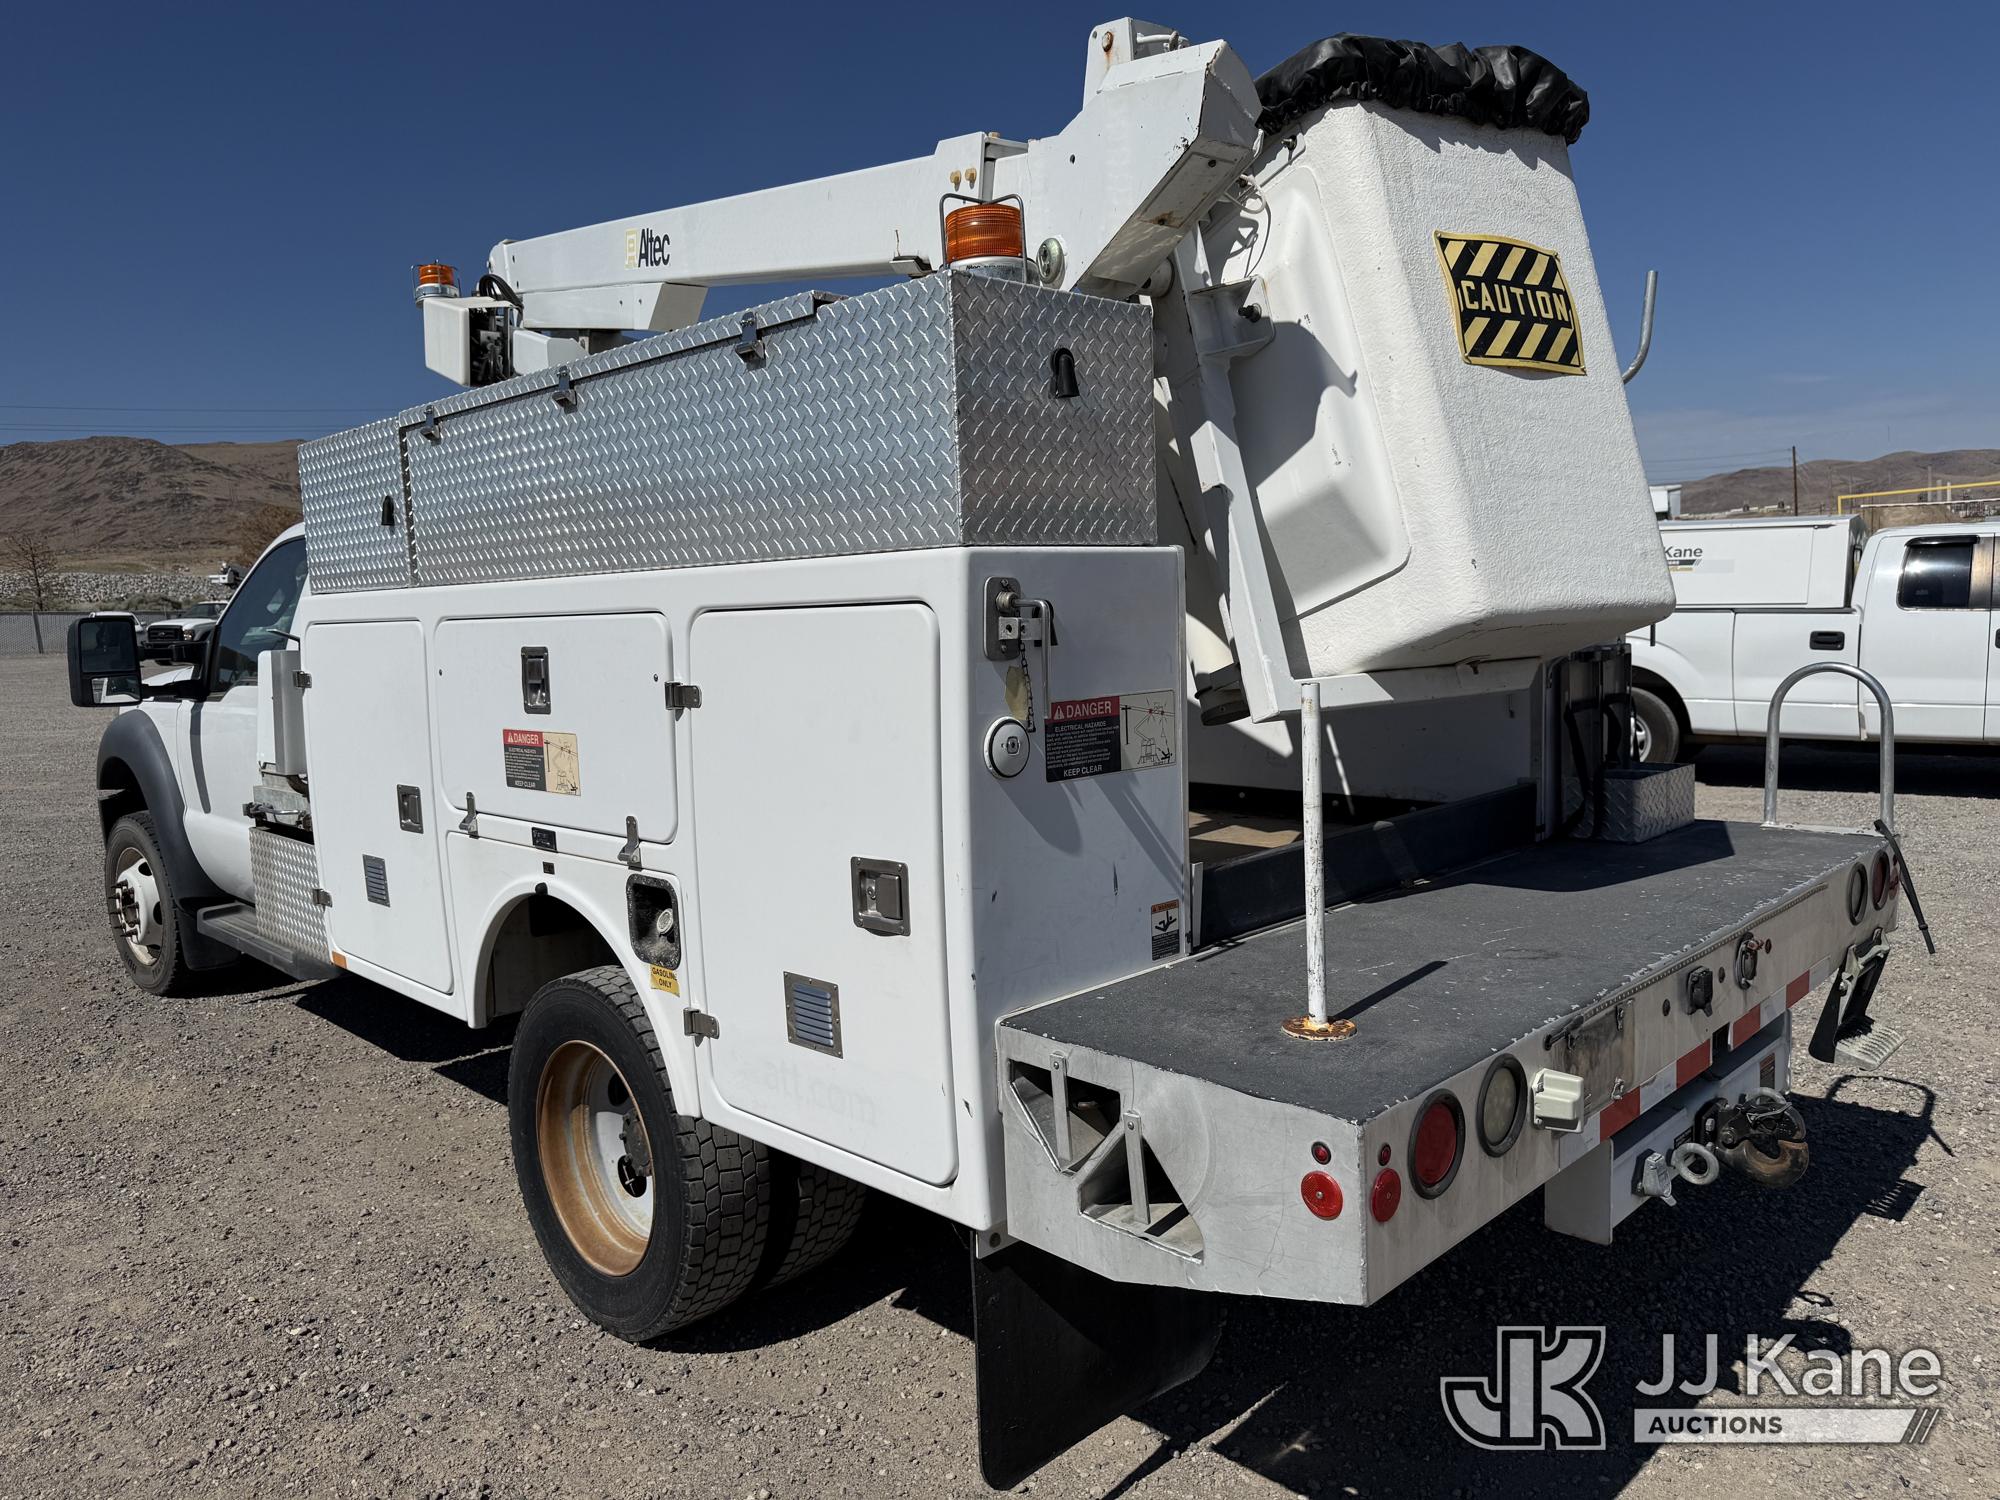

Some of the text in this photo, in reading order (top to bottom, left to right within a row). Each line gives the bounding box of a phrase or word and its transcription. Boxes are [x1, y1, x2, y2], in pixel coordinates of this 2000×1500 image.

[638, 228, 670, 267] Altec
[1460, 280, 1569, 322] CAUTION
[1664, 546, 1703, 558] Kane
[1066, 701, 1112, 718] DANGER
[1055, 723, 1084, 733] ELECTRICAL
[513, 733, 539, 745] DANGER
[1063, 764, 1103, 777] KEEP CLEAR
[658, 978, 672, 988] ONLY
